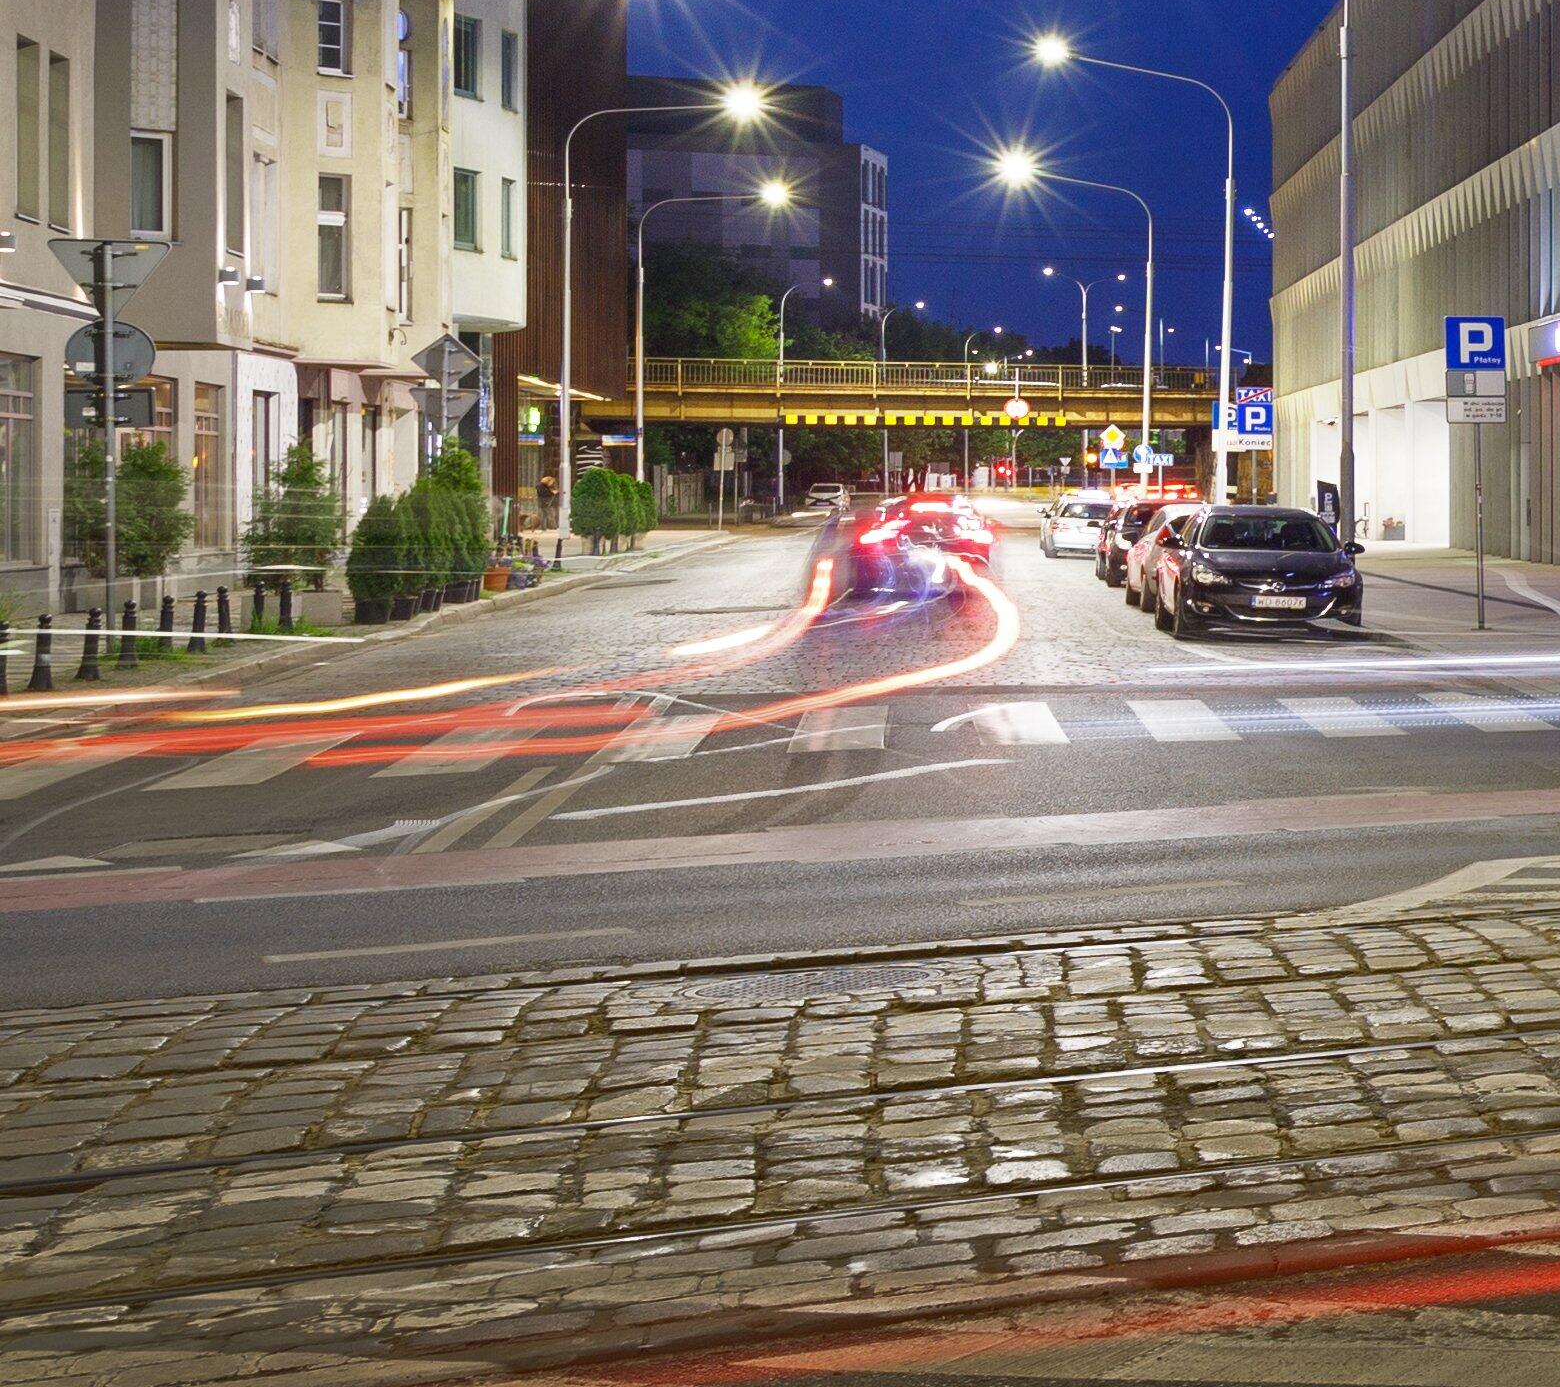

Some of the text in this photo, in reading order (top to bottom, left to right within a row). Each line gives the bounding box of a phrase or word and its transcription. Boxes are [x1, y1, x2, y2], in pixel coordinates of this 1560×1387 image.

[1459, 322, 1493, 364] P
[1238, 389, 1272, 402] TAXI
[1245, 407, 1266, 432] P
[1149, 454, 1172, 465] TAXI
